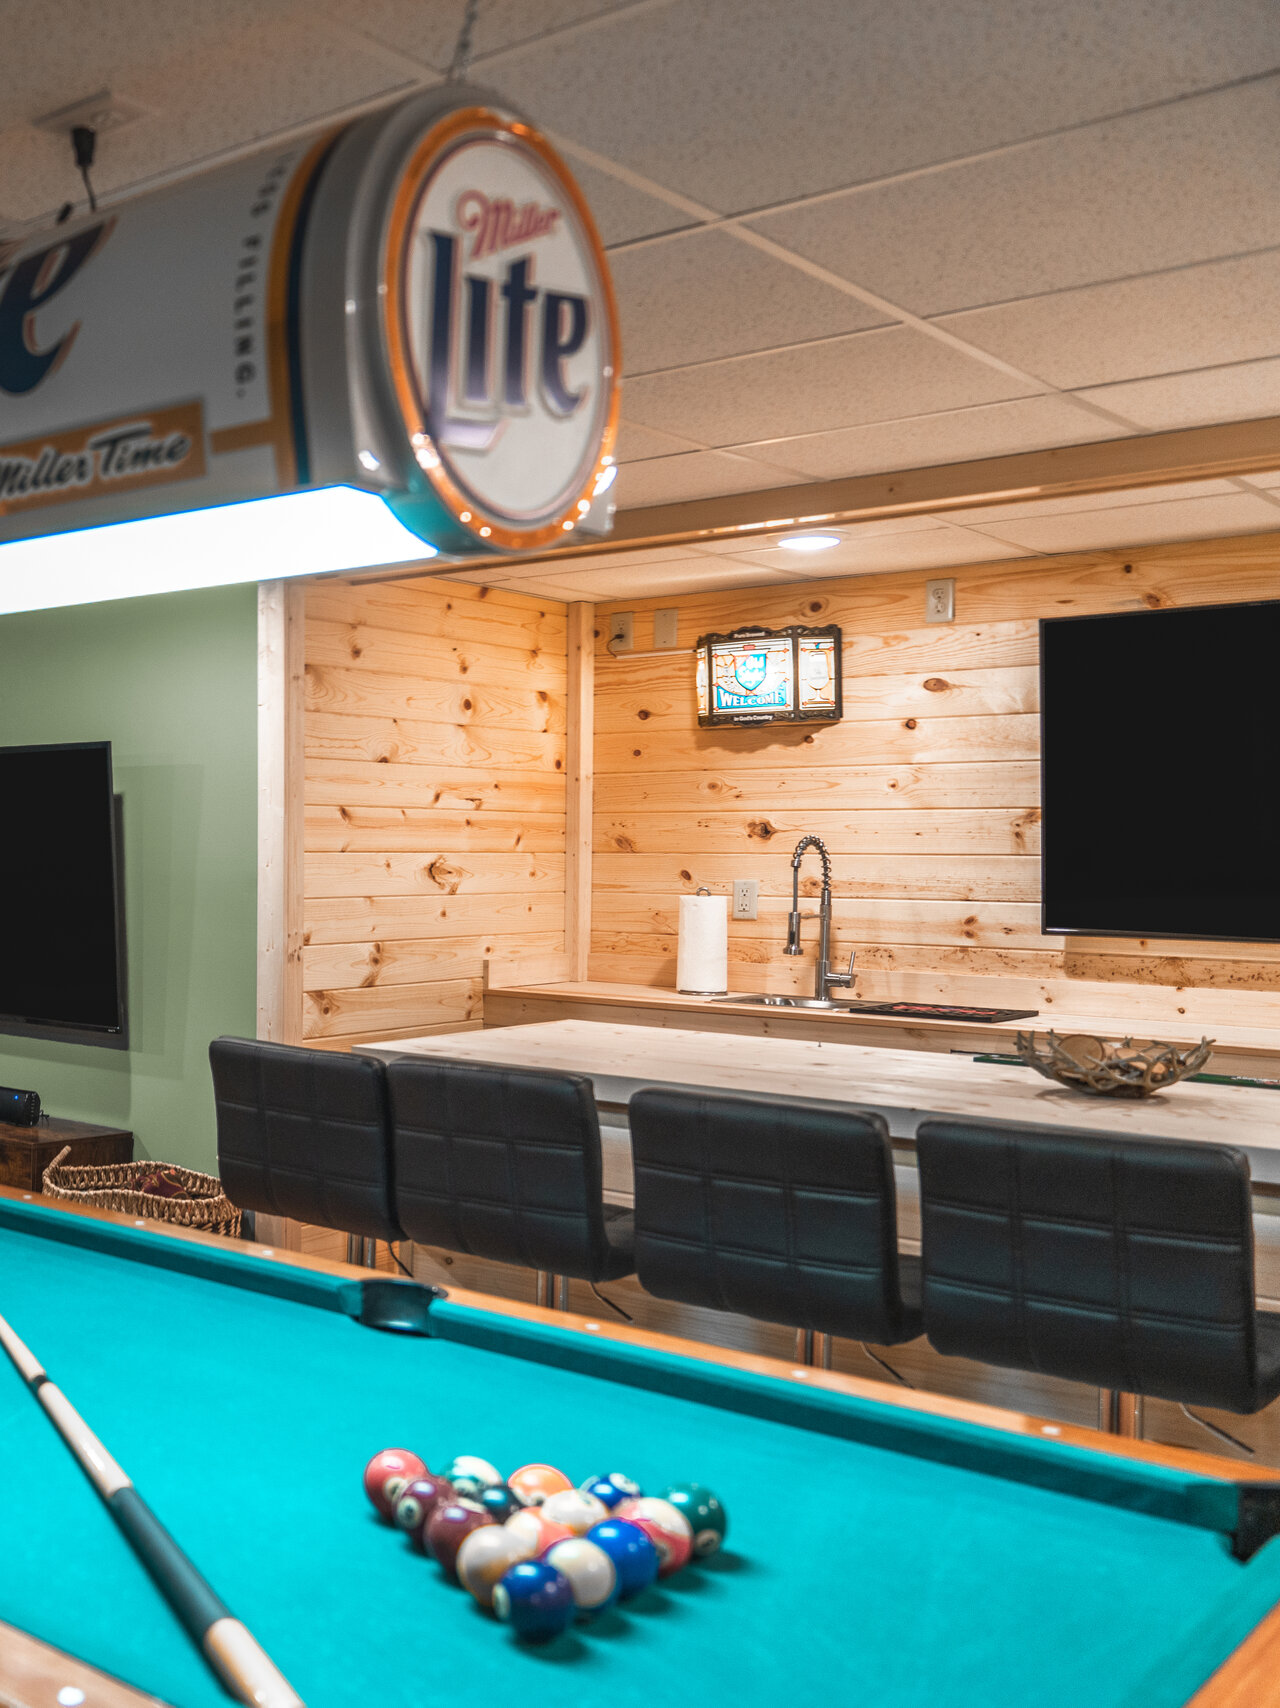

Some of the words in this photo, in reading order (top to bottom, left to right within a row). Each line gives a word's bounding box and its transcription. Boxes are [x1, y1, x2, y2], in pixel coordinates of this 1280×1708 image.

[457, 189, 560, 261] Miller
[425, 230, 590, 450] Lite
[88, 427, 189, 477] Time
[718, 688, 783, 707] WELCOME
